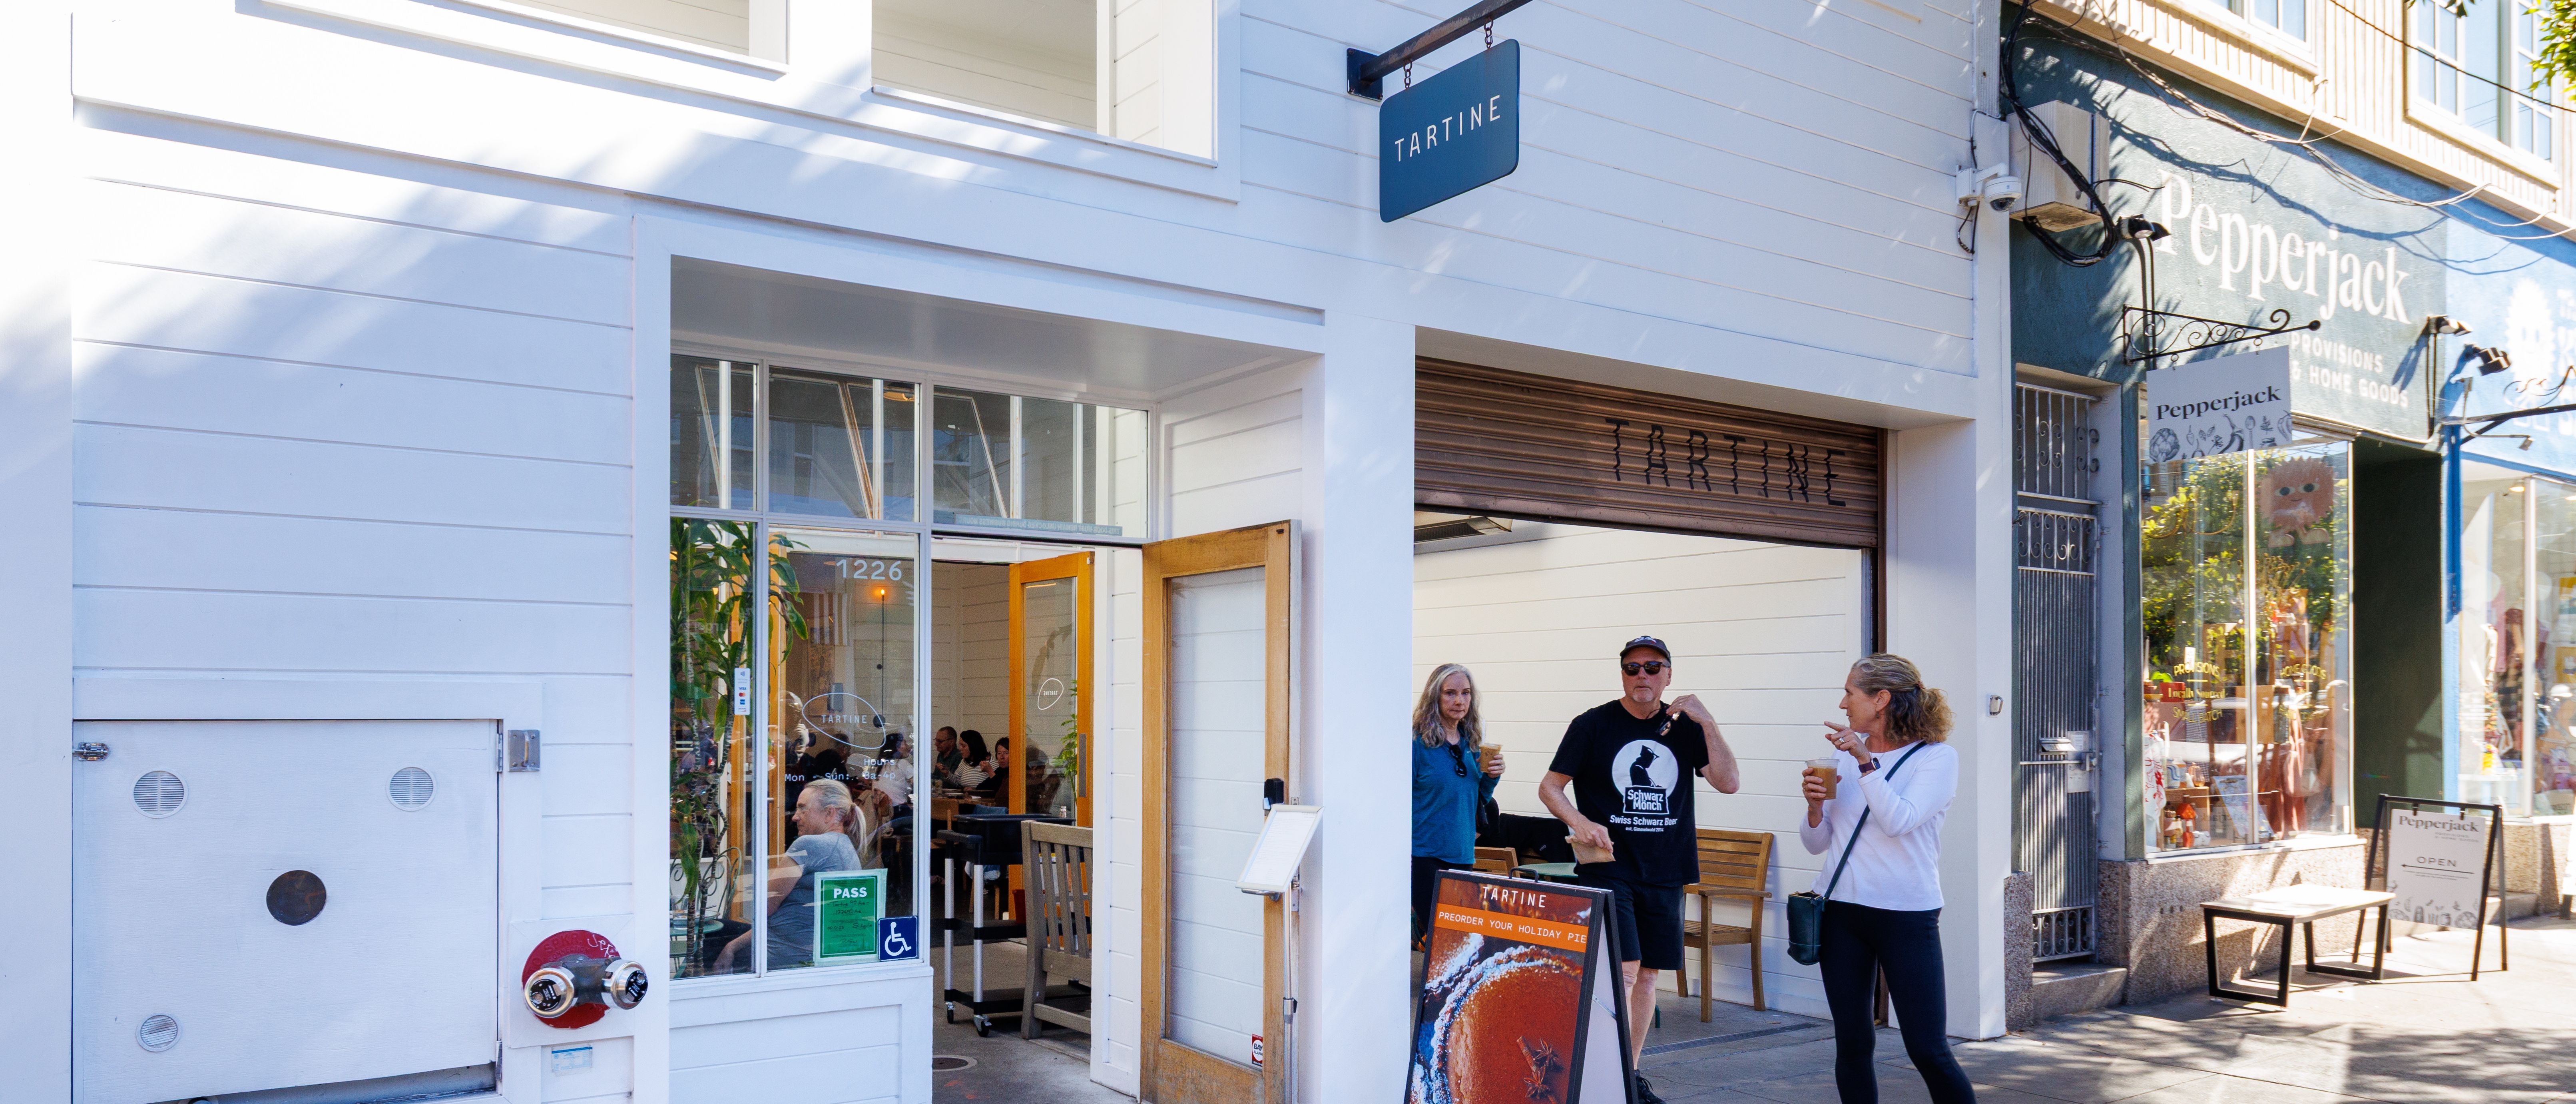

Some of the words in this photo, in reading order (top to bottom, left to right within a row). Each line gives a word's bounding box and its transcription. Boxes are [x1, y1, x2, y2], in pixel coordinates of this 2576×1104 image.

[1395, 94, 1500, 162] TARTINE
[2156, 169, 2411, 324] Pepperjack
[2291, 331, 2384, 373] PROVISIONS
[2291, 360, 2301, 380] &
[2309, 365, 2352, 394] HOME
[2358, 378, 2409, 408] GOODS
[2156, 386, 2281, 420] Pepperjack
[1605, 418, 1846, 507] TARTINE
[836, 559, 902, 581] 1226
[821, 715, 867, 723] TARTINE
[864, 771, 896, 780] 8a-4p
[1627, 789, 1664, 801] Schwarz
[1633, 799, 1662, 811] Mönch
[1610, 815, 1632, 824] Swiss
[1633, 817, 1664, 826] Schwarz
[1664, 817, 1678, 826] Beer
[2399, 815, 2480, 832] Pepperjack
[2417, 856, 2456, 867] OPEN
[833, 887, 867, 899] PASS
[1482, 887, 1547, 908] TARTINE
[1438, 911, 1484, 927] PREORDER
[1490, 919, 1513, 931] YOUR
[1518, 925, 1562, 939] HOLIDAY
[1568, 933, 1587, 943] PIE
